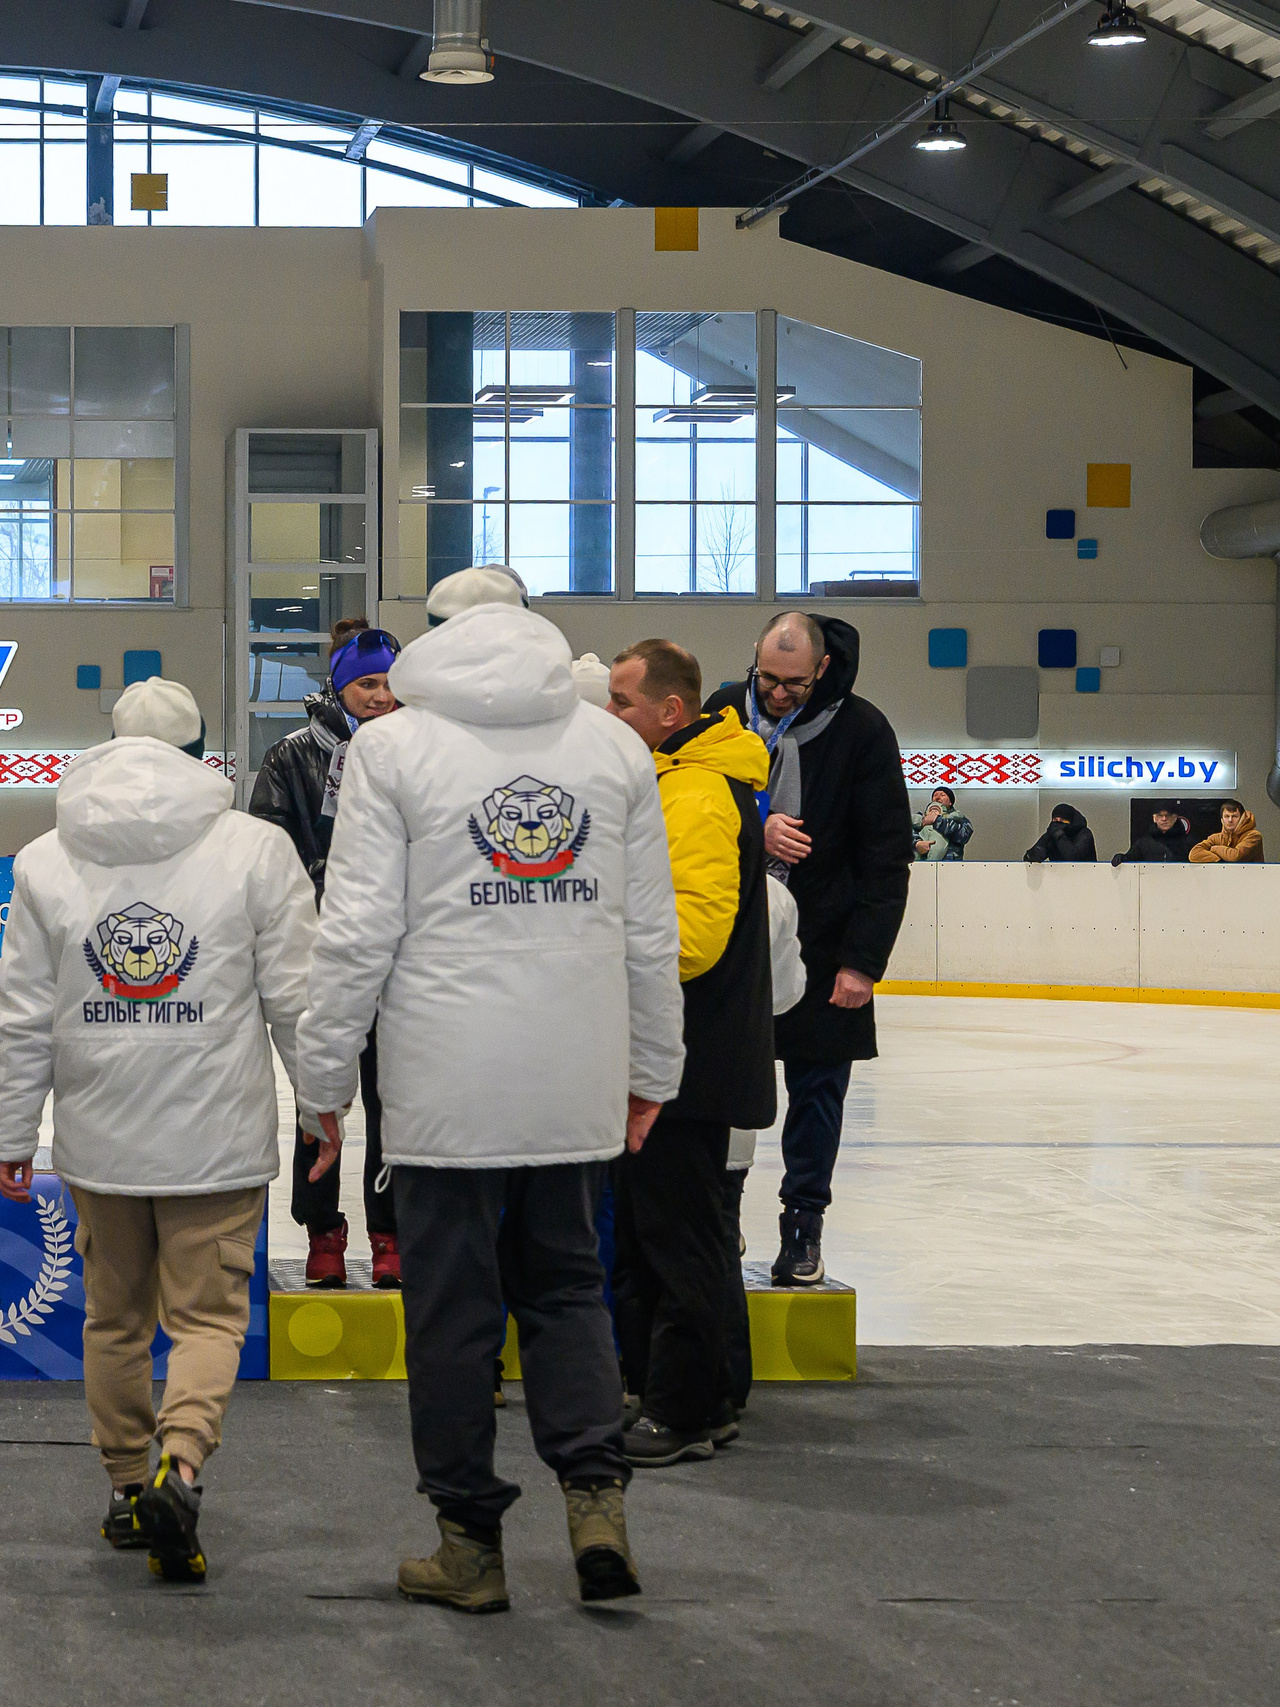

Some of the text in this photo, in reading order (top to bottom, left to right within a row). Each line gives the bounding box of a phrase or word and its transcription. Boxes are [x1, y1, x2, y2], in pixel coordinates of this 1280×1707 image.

[1060, 755, 1219, 783] silichy.by
[470, 877, 598, 906] БЕЛЫЕ ТИГРЫ
[83, 1001, 203, 1023] БЕЛЫЕ ТИГРЫ
